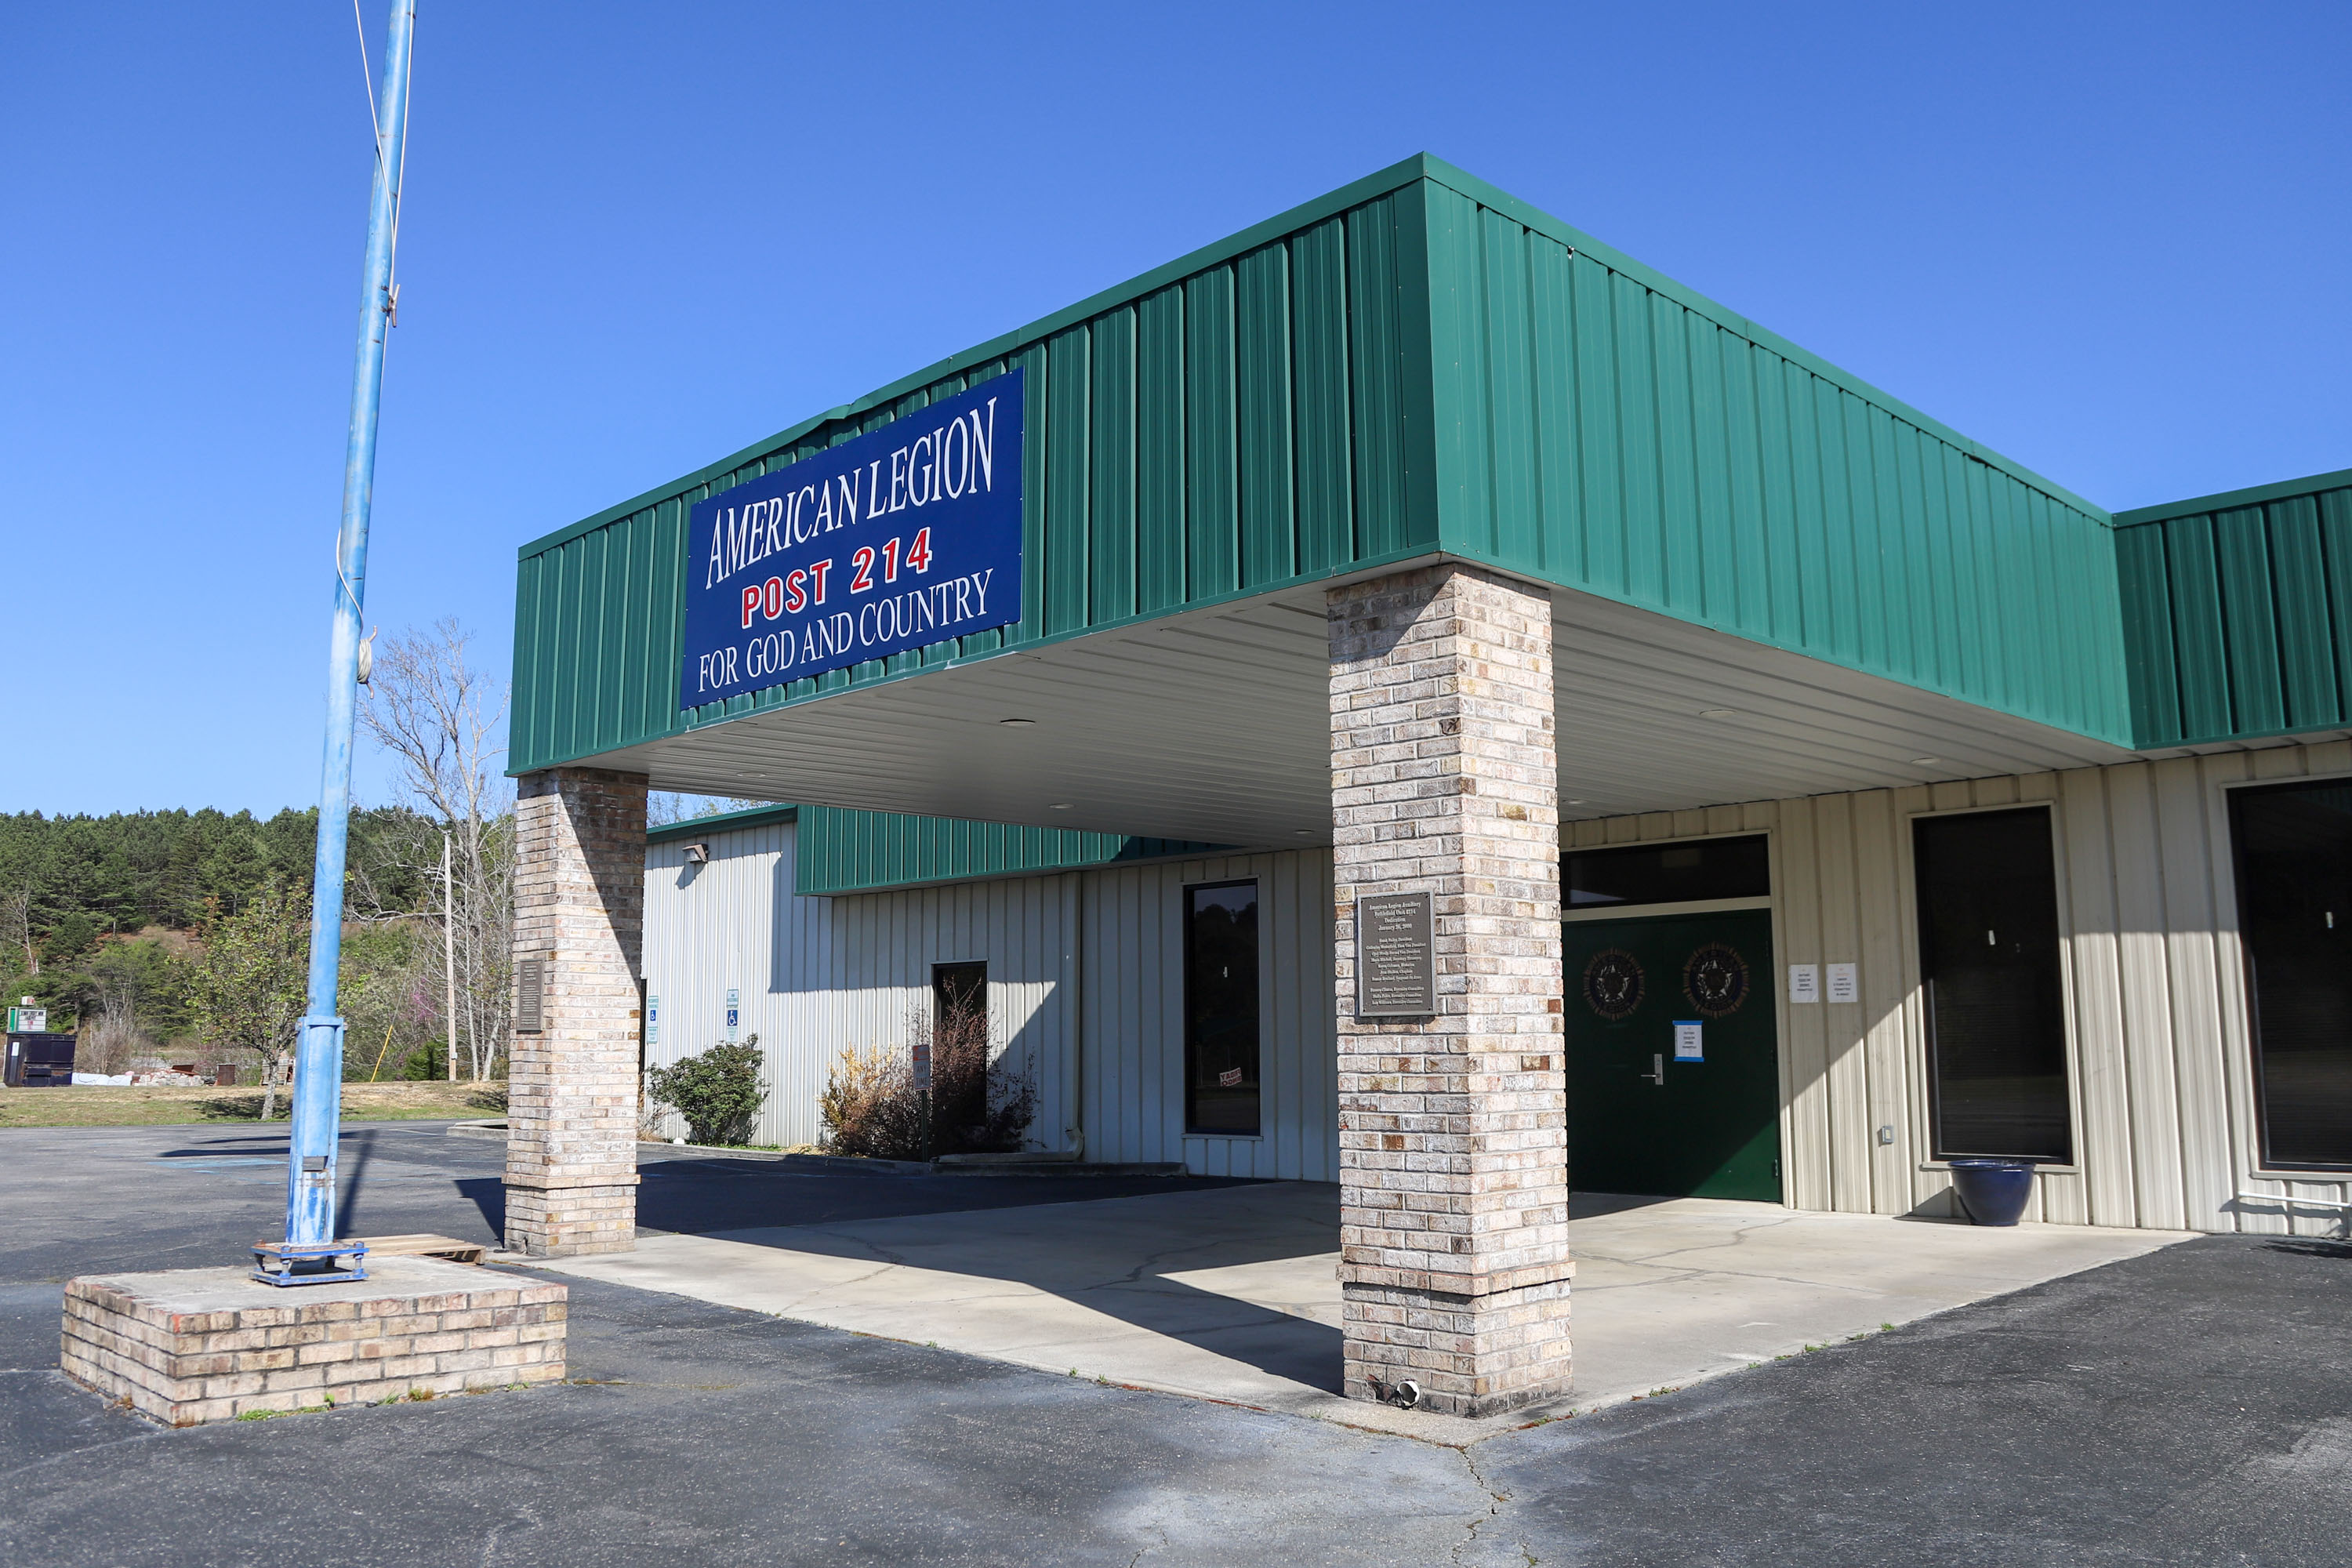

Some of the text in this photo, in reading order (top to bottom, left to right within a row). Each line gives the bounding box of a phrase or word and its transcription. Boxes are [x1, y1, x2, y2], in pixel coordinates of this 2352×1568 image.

[705, 396, 997, 590] AMERICAN LEGION
[698, 568, 994, 693] FOR GOD AND COUNTRY
[741, 526, 932, 630] POST 214
[916, 1077, 927, 1086] TIME
